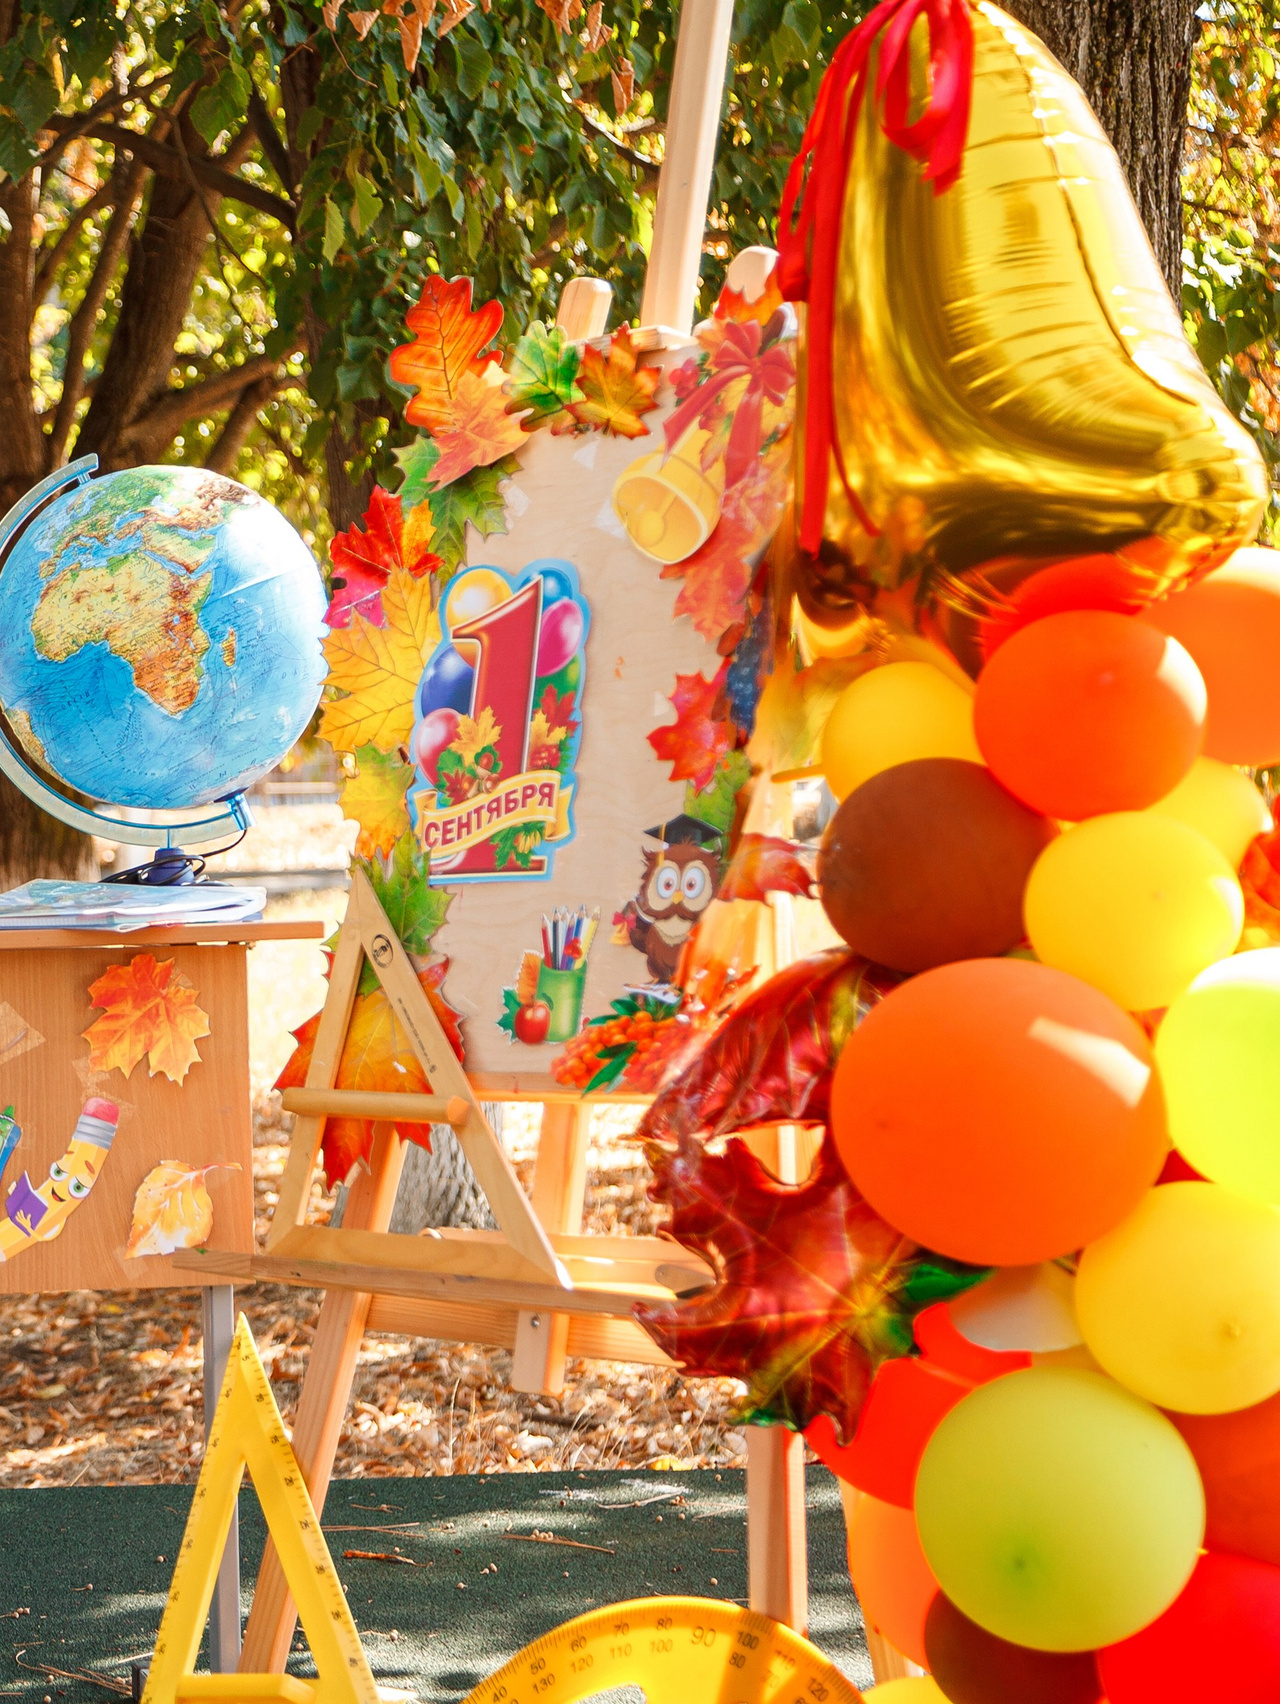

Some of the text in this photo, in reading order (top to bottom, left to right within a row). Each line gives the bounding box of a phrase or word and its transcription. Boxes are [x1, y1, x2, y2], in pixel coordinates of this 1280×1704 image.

[424, 782, 556, 849] СЕНТЯБРЯ
[492, 1685, 508, 1703] 40
[530, 1657, 546, 1675] 50
[570, 1635, 587, 1652] 60
[614, 1622, 630, 1637] 70
[656, 1617, 673, 1632] 80
[691, 1625, 717, 1647] 90
[736, 1630, 760, 1650] 100
[807, 1677, 830, 1702] 120
[532, 1673, 556, 1695] 130
[571, 1654, 594, 1674] 120
[610, 1643, 632, 1659] 110
[649, 1638, 674, 1654] 100
[728, 1651, 746, 1669] 80
